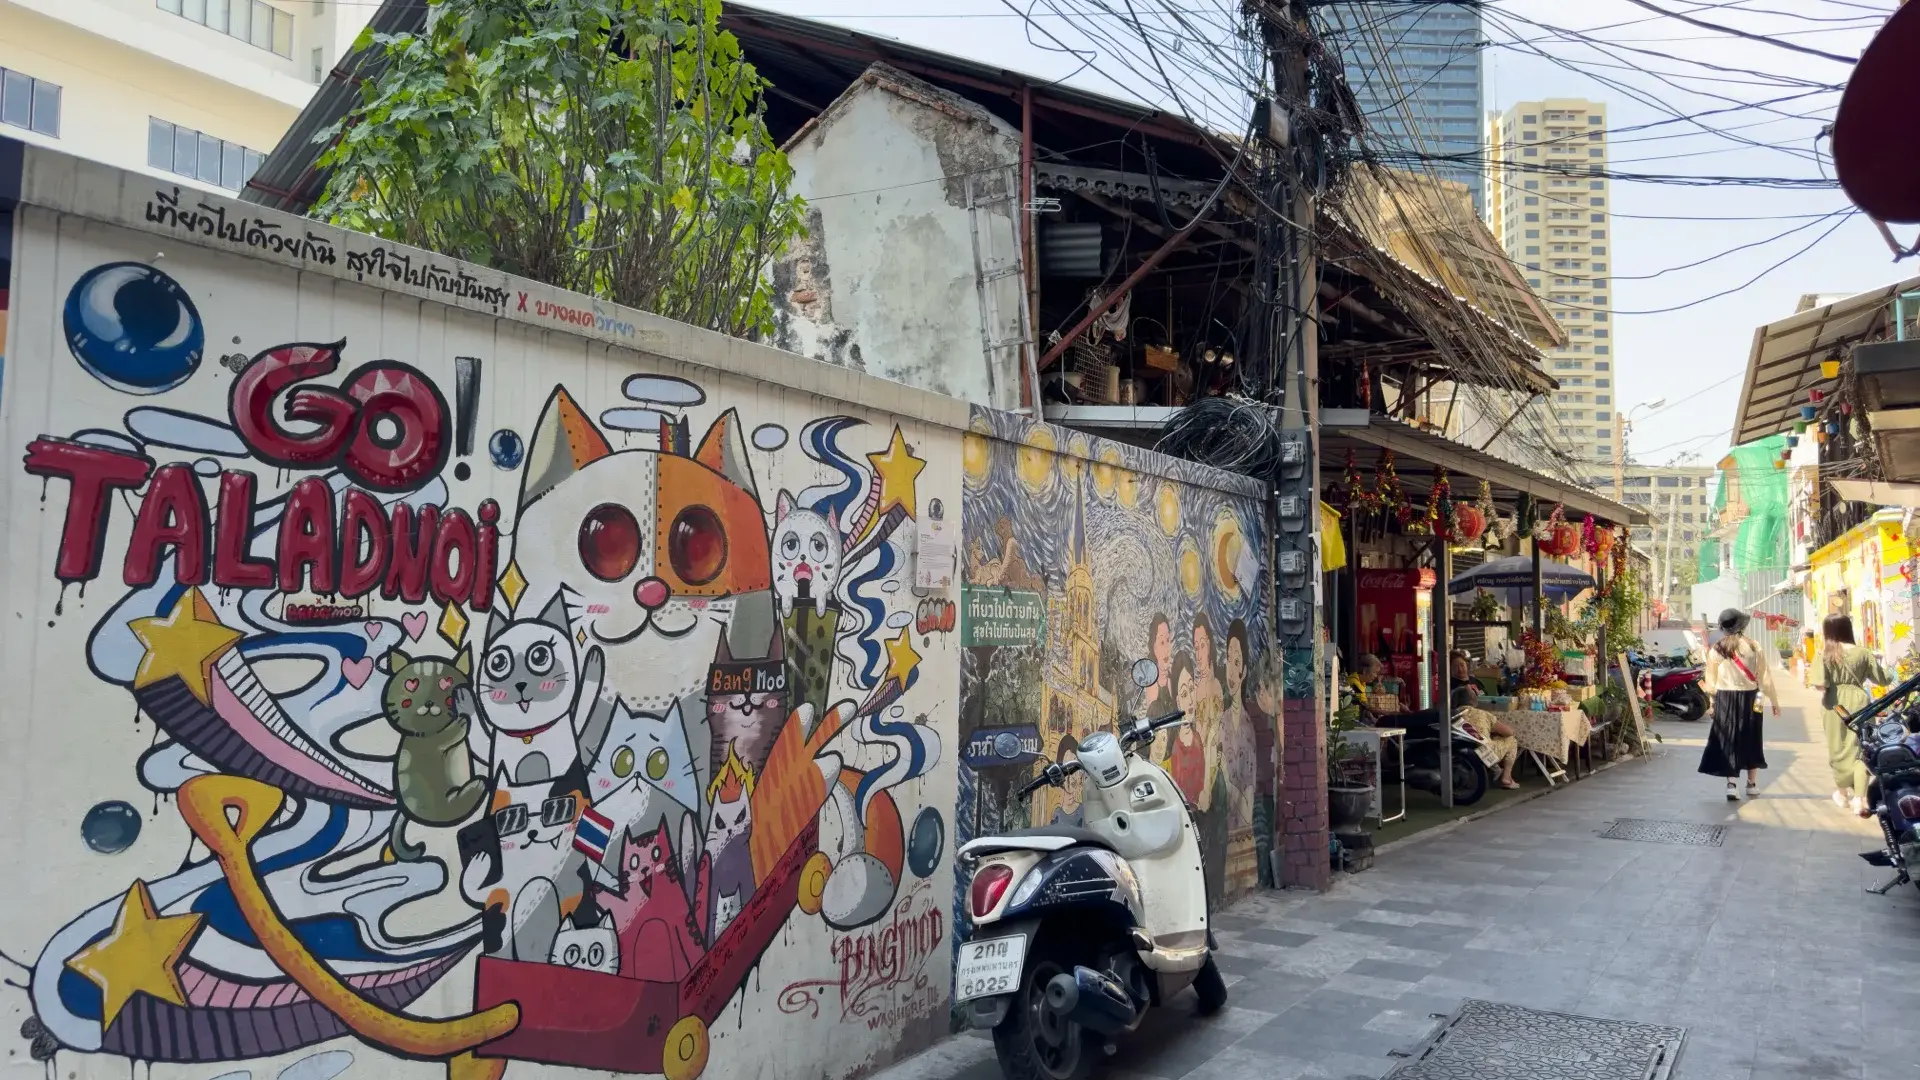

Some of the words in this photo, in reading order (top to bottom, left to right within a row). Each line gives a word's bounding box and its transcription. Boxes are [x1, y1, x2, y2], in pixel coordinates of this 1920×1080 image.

[145, 187, 336, 265] เที่ยวไปด้วยกัน
[968, 592, 1039, 619] เที่ยวไปด้วยกัน
[973, 621, 1036, 643] สุขใจไปกับปันสุข
[712, 663, 752, 692] Bang
[756, 667, 785, 691] Mod
